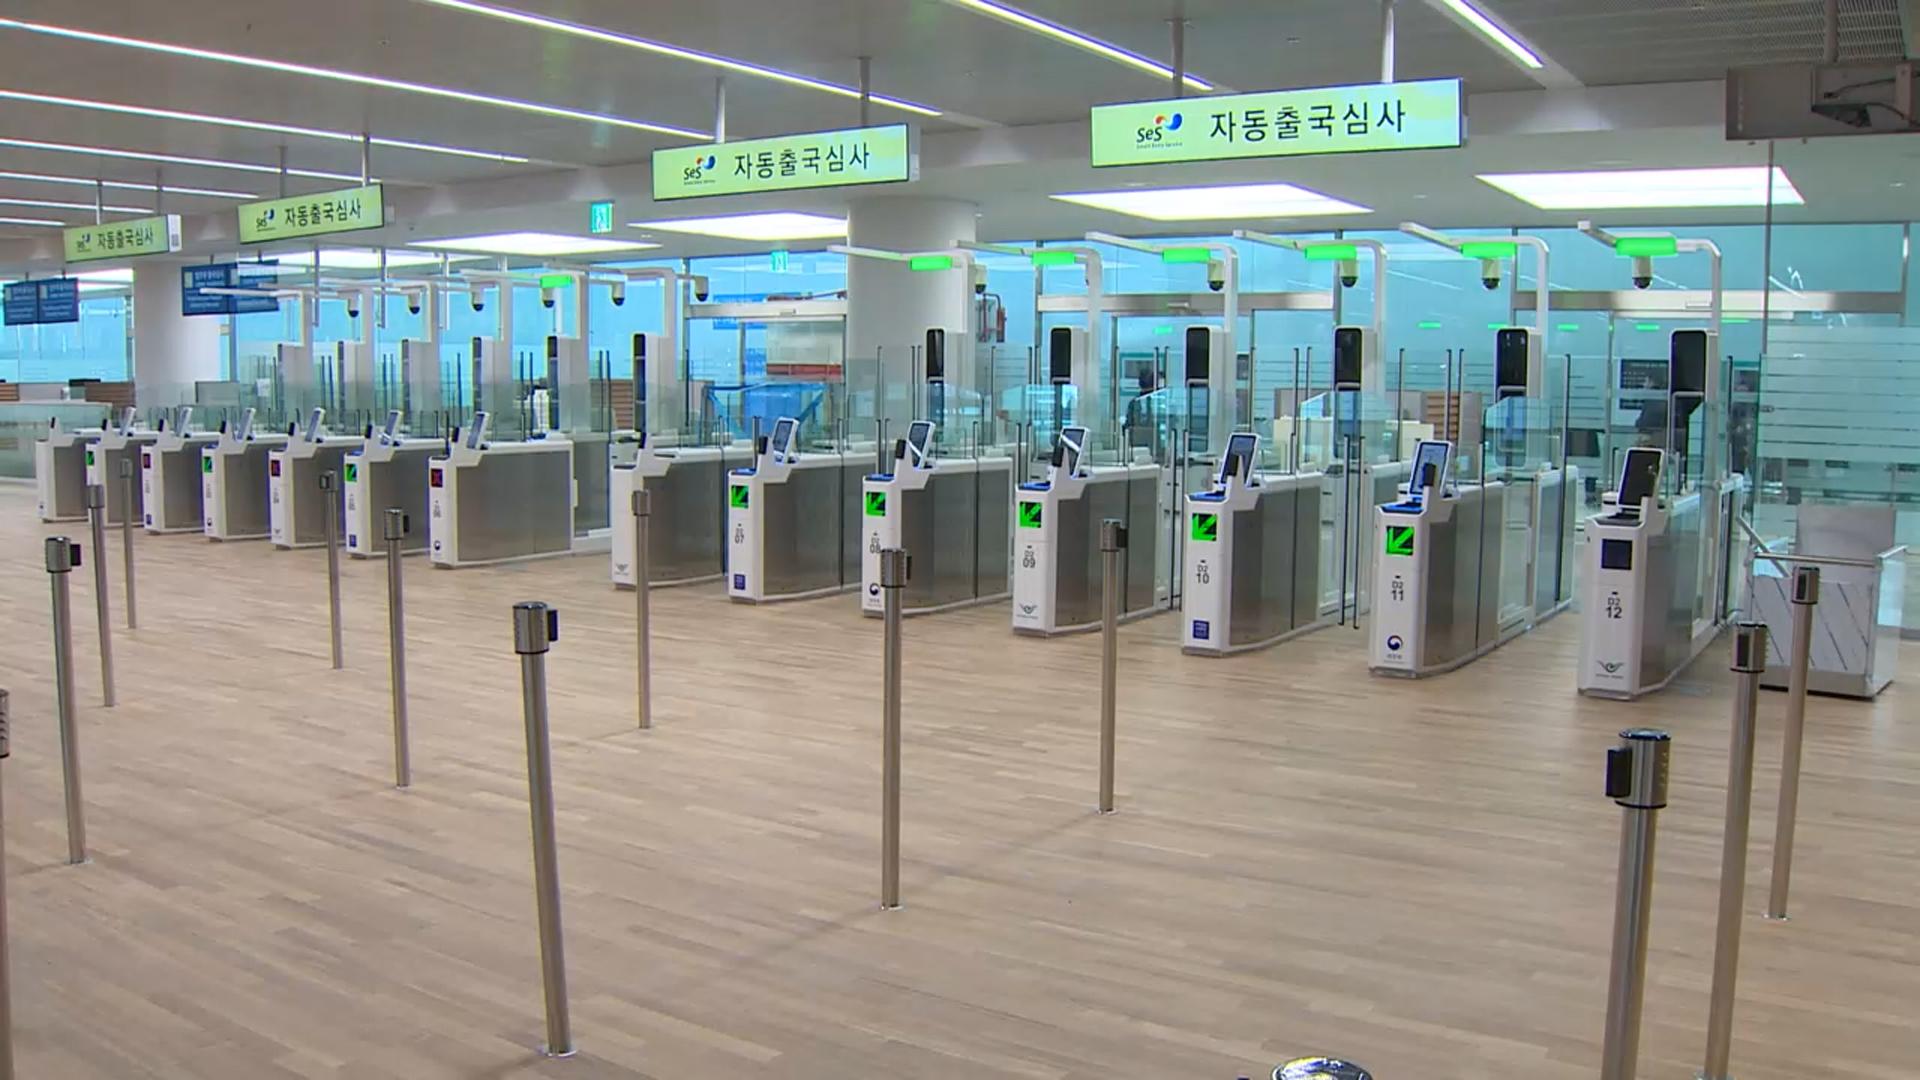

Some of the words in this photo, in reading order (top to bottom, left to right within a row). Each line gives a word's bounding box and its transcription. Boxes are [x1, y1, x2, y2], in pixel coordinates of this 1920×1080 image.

[1209, 99, 1406, 143] 자동출국심사
[734, 142, 870, 180] 자동출국심사
[284, 198, 361, 228] 자동출국심사
[96, 228, 154, 250] 자동출국심사
[734, 534, 745, 544] 07
[1022, 557, 1036, 568] 09
[1197, 565, 1208, 573] D2
[1196, 573, 1210, 584] 10
[1391, 580, 1403, 589] D2
[1391, 589, 1404, 601] 11
[1608, 597, 1620, 606] D2
[1606, 606, 1623, 619] 12
